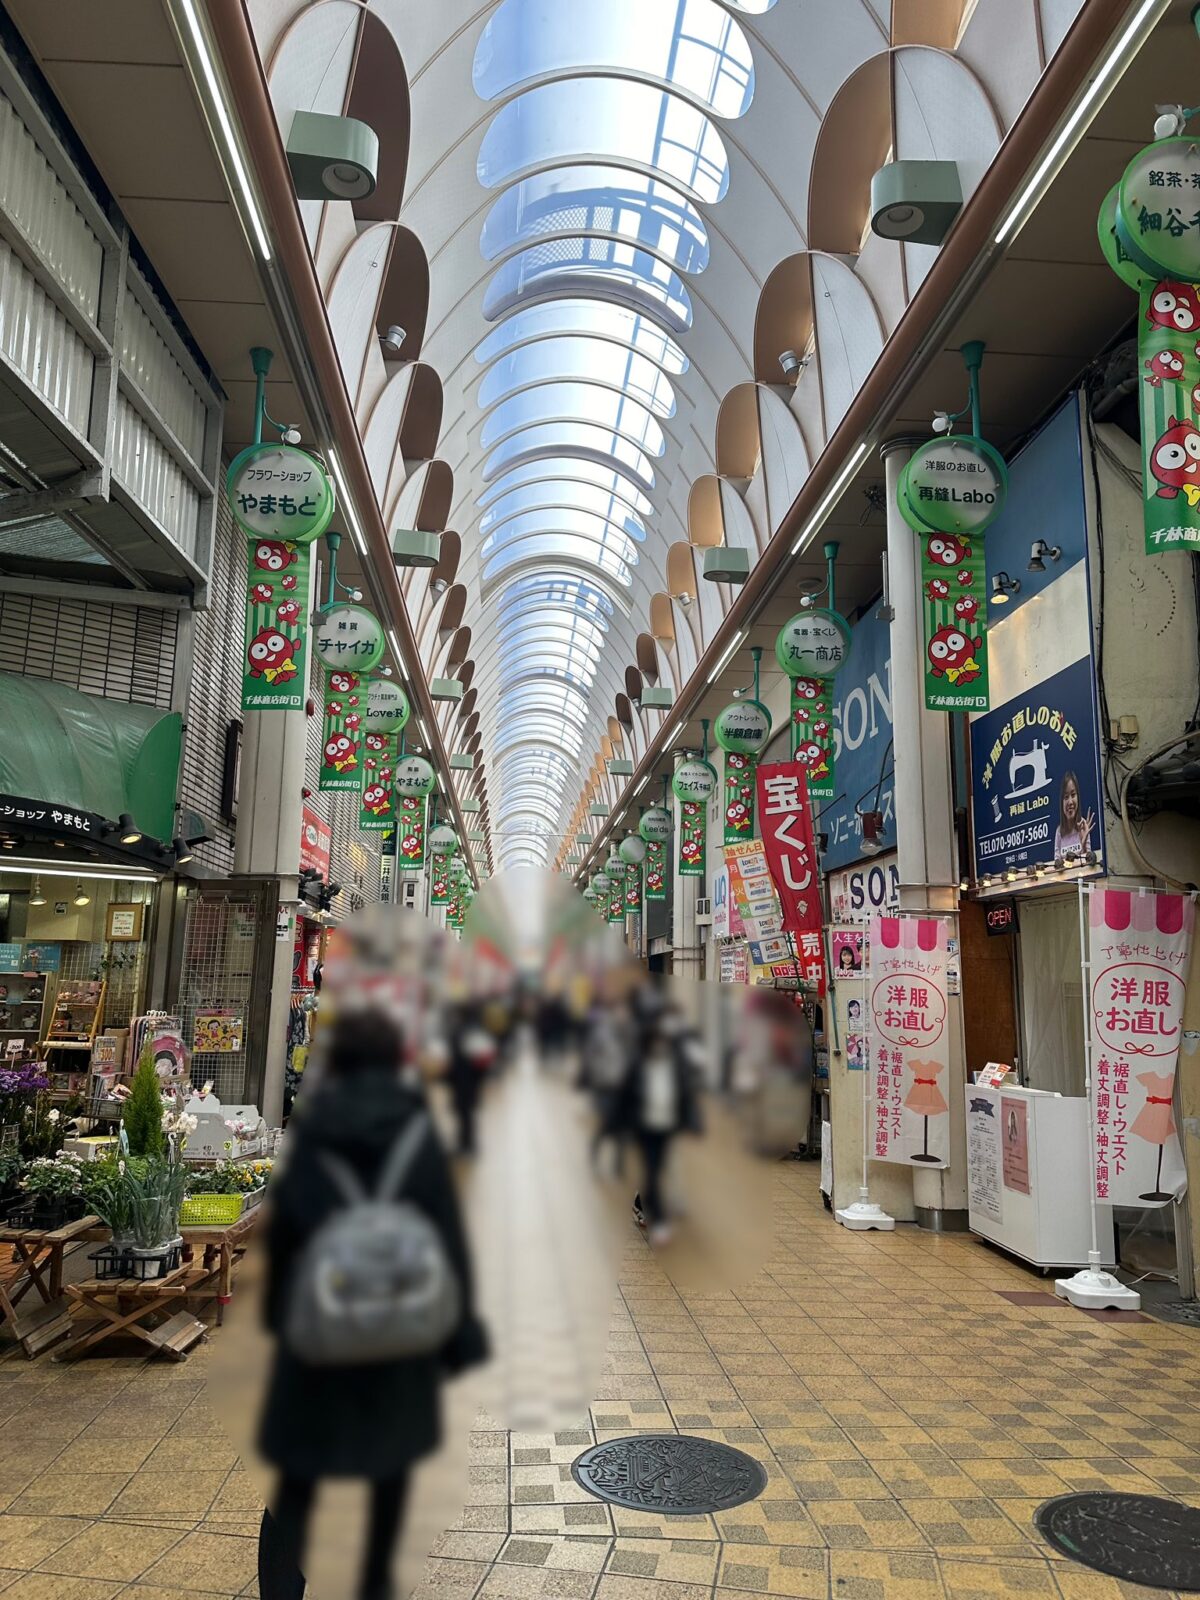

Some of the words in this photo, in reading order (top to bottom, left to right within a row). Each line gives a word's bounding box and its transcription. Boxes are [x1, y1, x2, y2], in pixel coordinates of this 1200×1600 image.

[247, 469, 312, 482] フラワーショップ
[925, 460, 986, 473] 洋服のお直し
[237, 493, 317, 517] やまもと
[918, 486, 995, 504] 再縫Labo
[1149, 526, 1200, 544] 千林商
[318, 638, 375, 655] チャイカ
[788, 644, 842, 661] 丸一商店
[727, 713, 761, 722] アウトレット
[982, 706, 1078, 790] 洋服お直しのお店
[396, 777, 430, 787] やまもと
[1026, 795, 1050, 812] Labo
[51, 810, 91, 832] やまもと
[764, 774, 812, 891] 宝くじ
[381, 858, 391, 904] 三井住友銀
[987, 907, 1012, 927] OPEN
[887, 985, 930, 1009] 洋服
[1110, 977, 1171, 1007] 洋服
[884, 1007, 935, 1032] お直し
[1105, 1006, 1178, 1036] お直し
